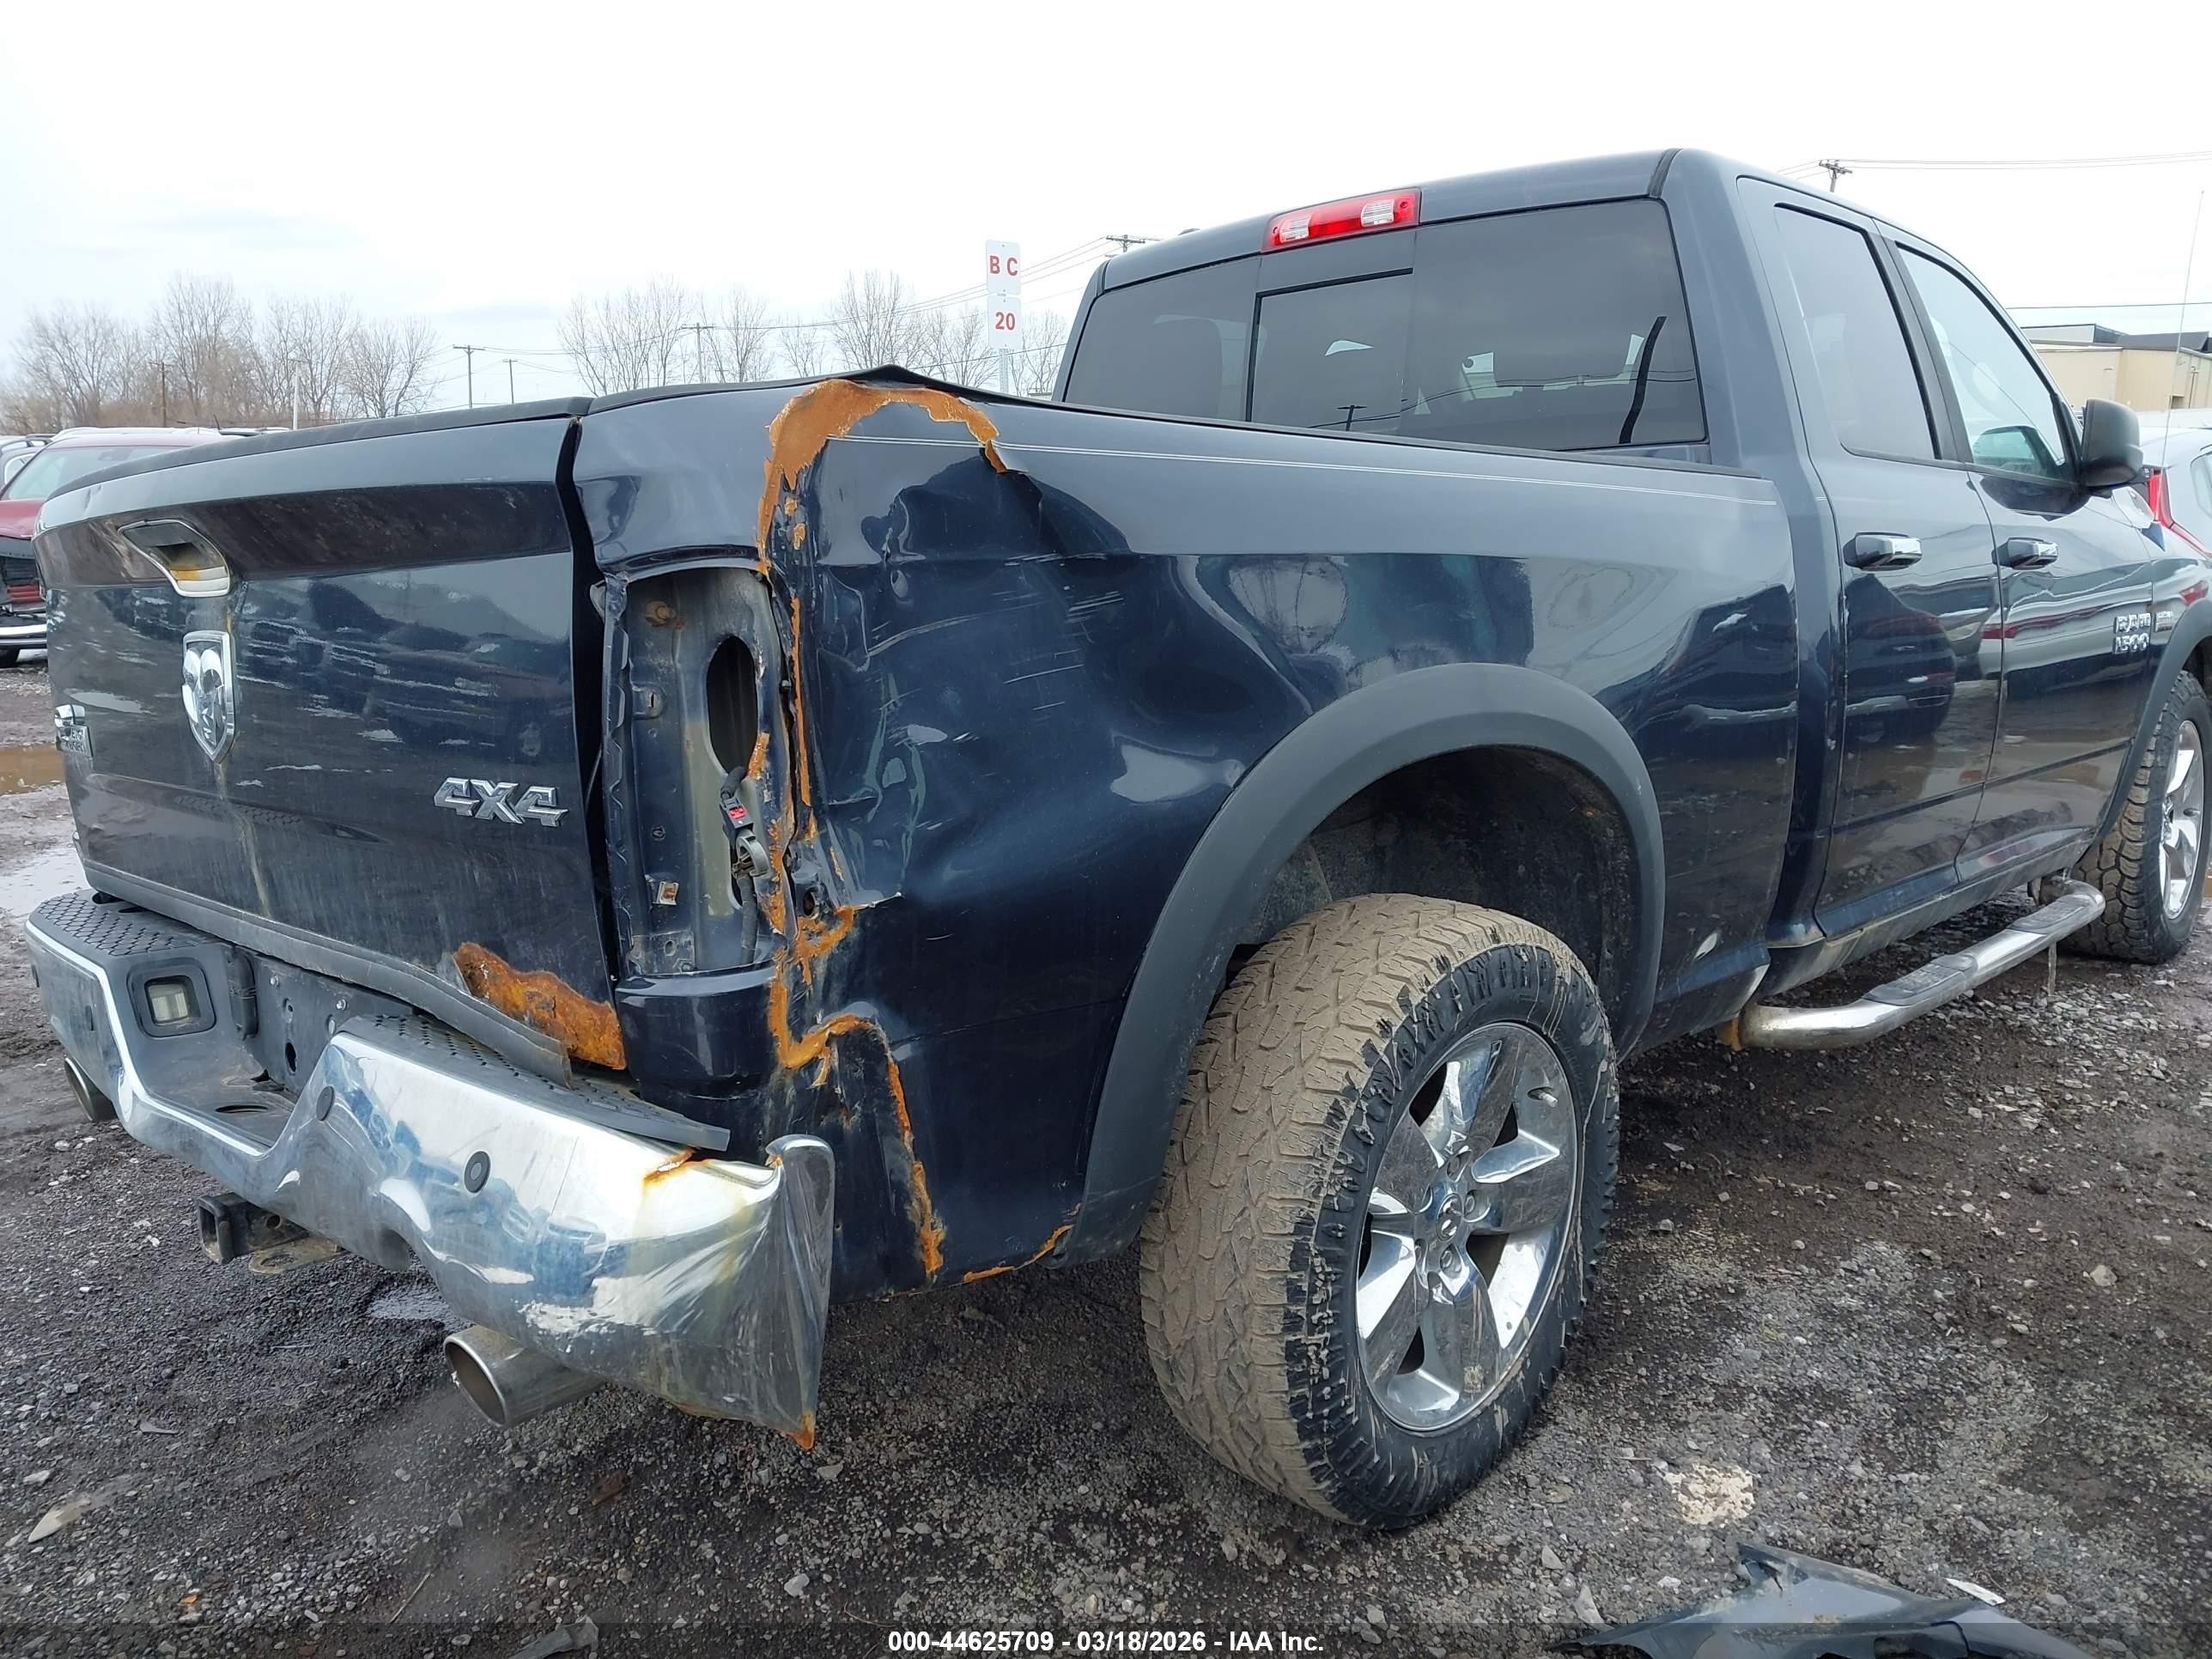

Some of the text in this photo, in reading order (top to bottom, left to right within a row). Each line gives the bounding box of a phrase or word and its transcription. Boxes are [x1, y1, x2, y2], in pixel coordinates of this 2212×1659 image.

[989, 255, 1018, 276] B C
[995, 312, 1016, 331] 20
[2115, 612, 2151, 634] RAM
[2114, 632, 2149, 654] 1500
